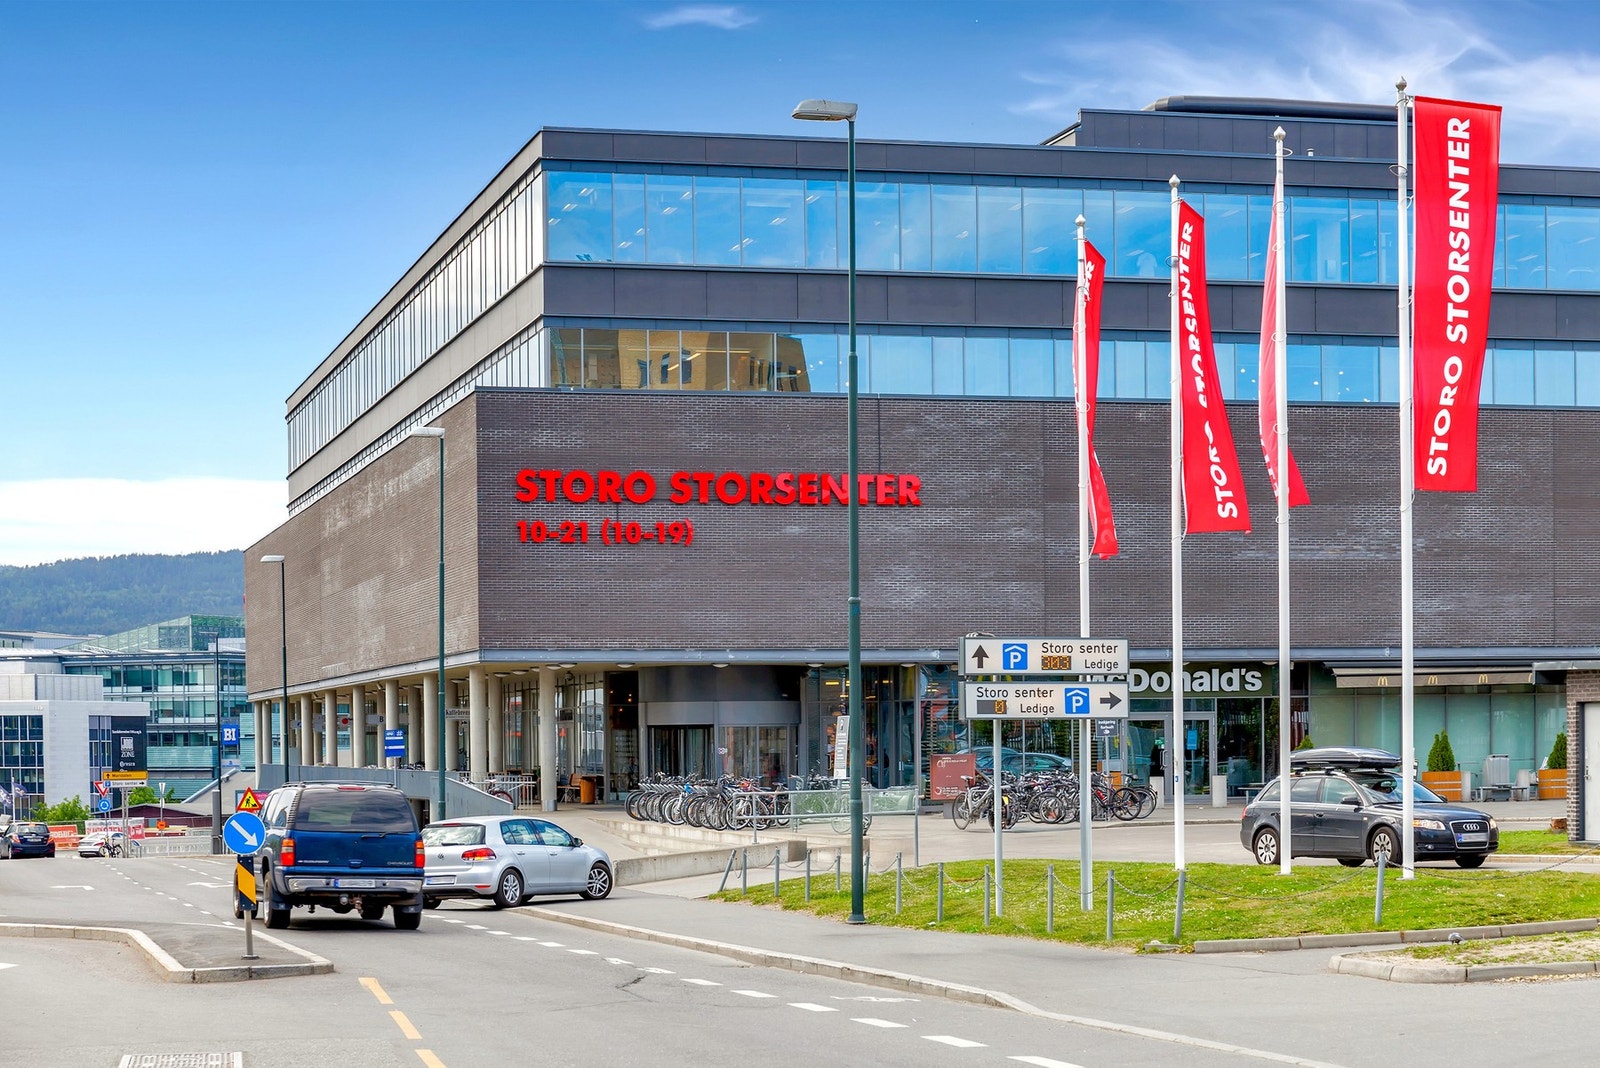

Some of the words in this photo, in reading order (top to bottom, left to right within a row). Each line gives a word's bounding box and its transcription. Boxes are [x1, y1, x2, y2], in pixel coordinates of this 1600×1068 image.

[1427, 355, 1463, 477] STORO
[1446, 117, 1471, 345] STORSENTER
[515, 469, 657, 505] STORO
[670, 472, 922, 506] STORSENTER
[517, 520, 590, 543] 10-21
[601, 519, 694, 546] (10-19)
[1041, 642, 1074, 654] Storo
[1079, 643, 1118, 654] senter
[1041, 656, 1070, 670] 303
[1084, 659, 1119, 671] Ledige
[976, 686, 1009, 698] Storo
[1014, 687, 1054, 698] senter
[1020, 703, 1055, 716] Ledige
